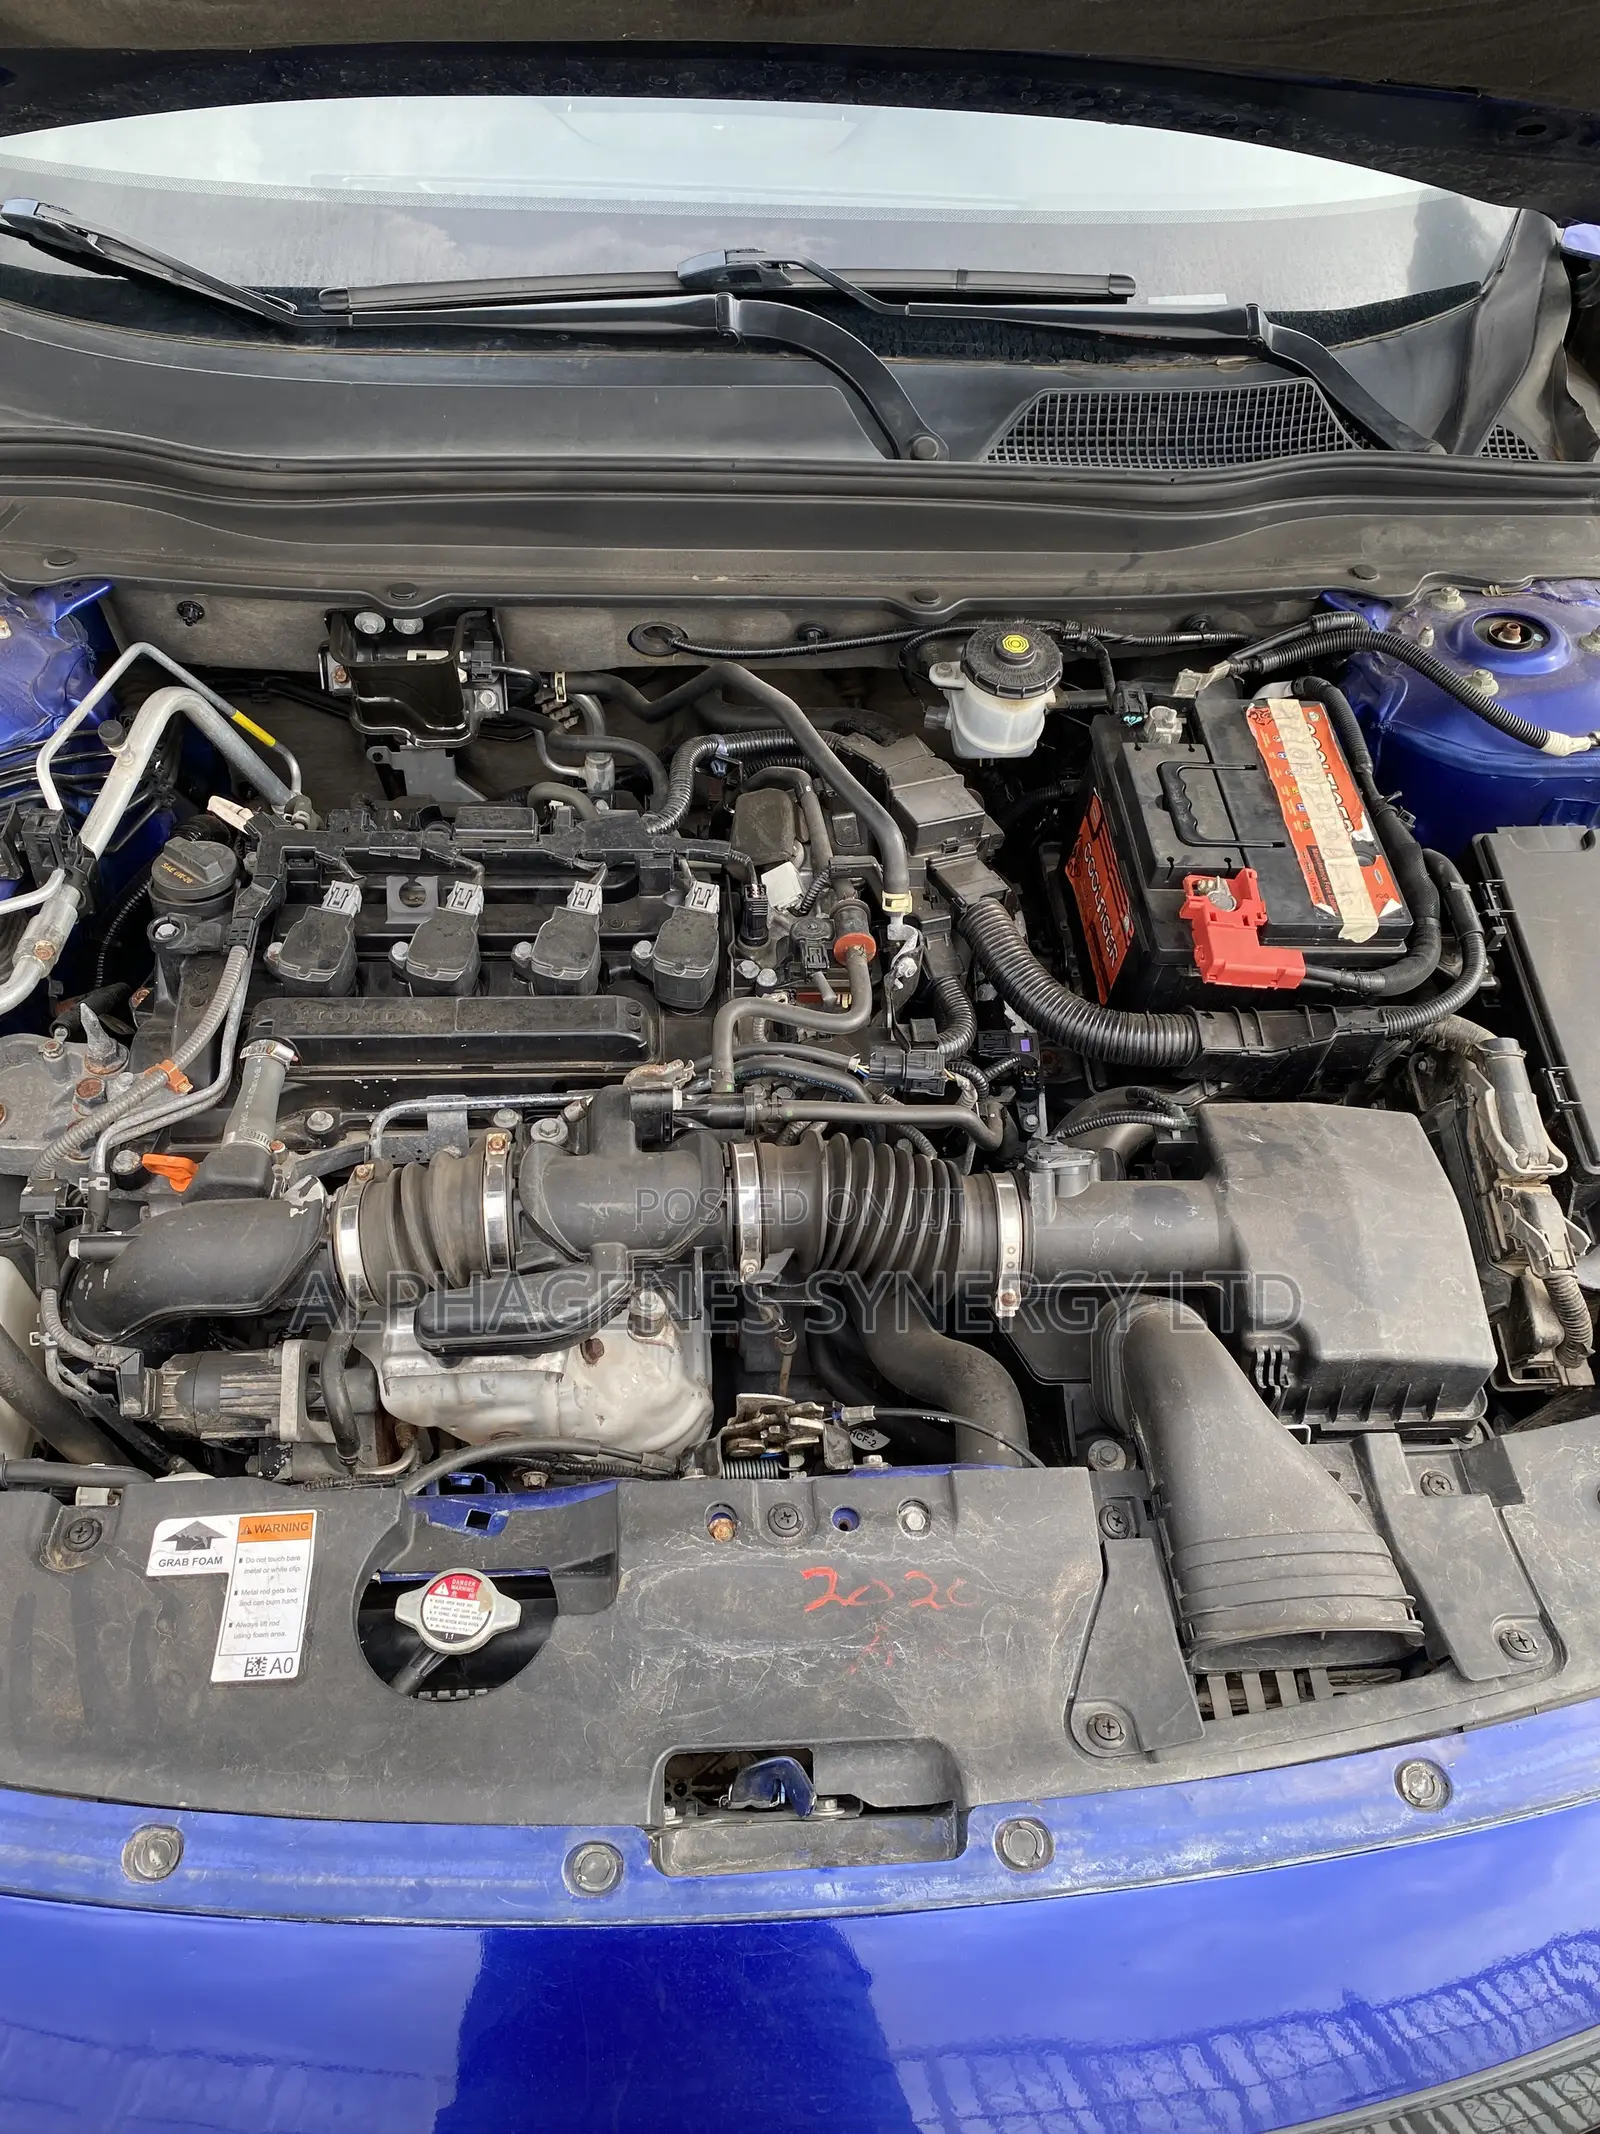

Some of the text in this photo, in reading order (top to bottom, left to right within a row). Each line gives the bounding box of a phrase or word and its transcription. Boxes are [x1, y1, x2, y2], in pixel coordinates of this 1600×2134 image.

[161, 862, 174, 873] SAE
[294, 1009, 433, 1024] HONDA
[849, 1429, 877, 1449] HCF-2
[254, 1521, 309, 1534] WARNING
[158, 1556, 223, 1567] GRAB FOAM
[451, 1578, 476, 1587] DANGER
[272, 1588, 285, 1596] gets
[451, 1584, 475, 1593] WARNING
[239, 1599, 252, 1607] and
